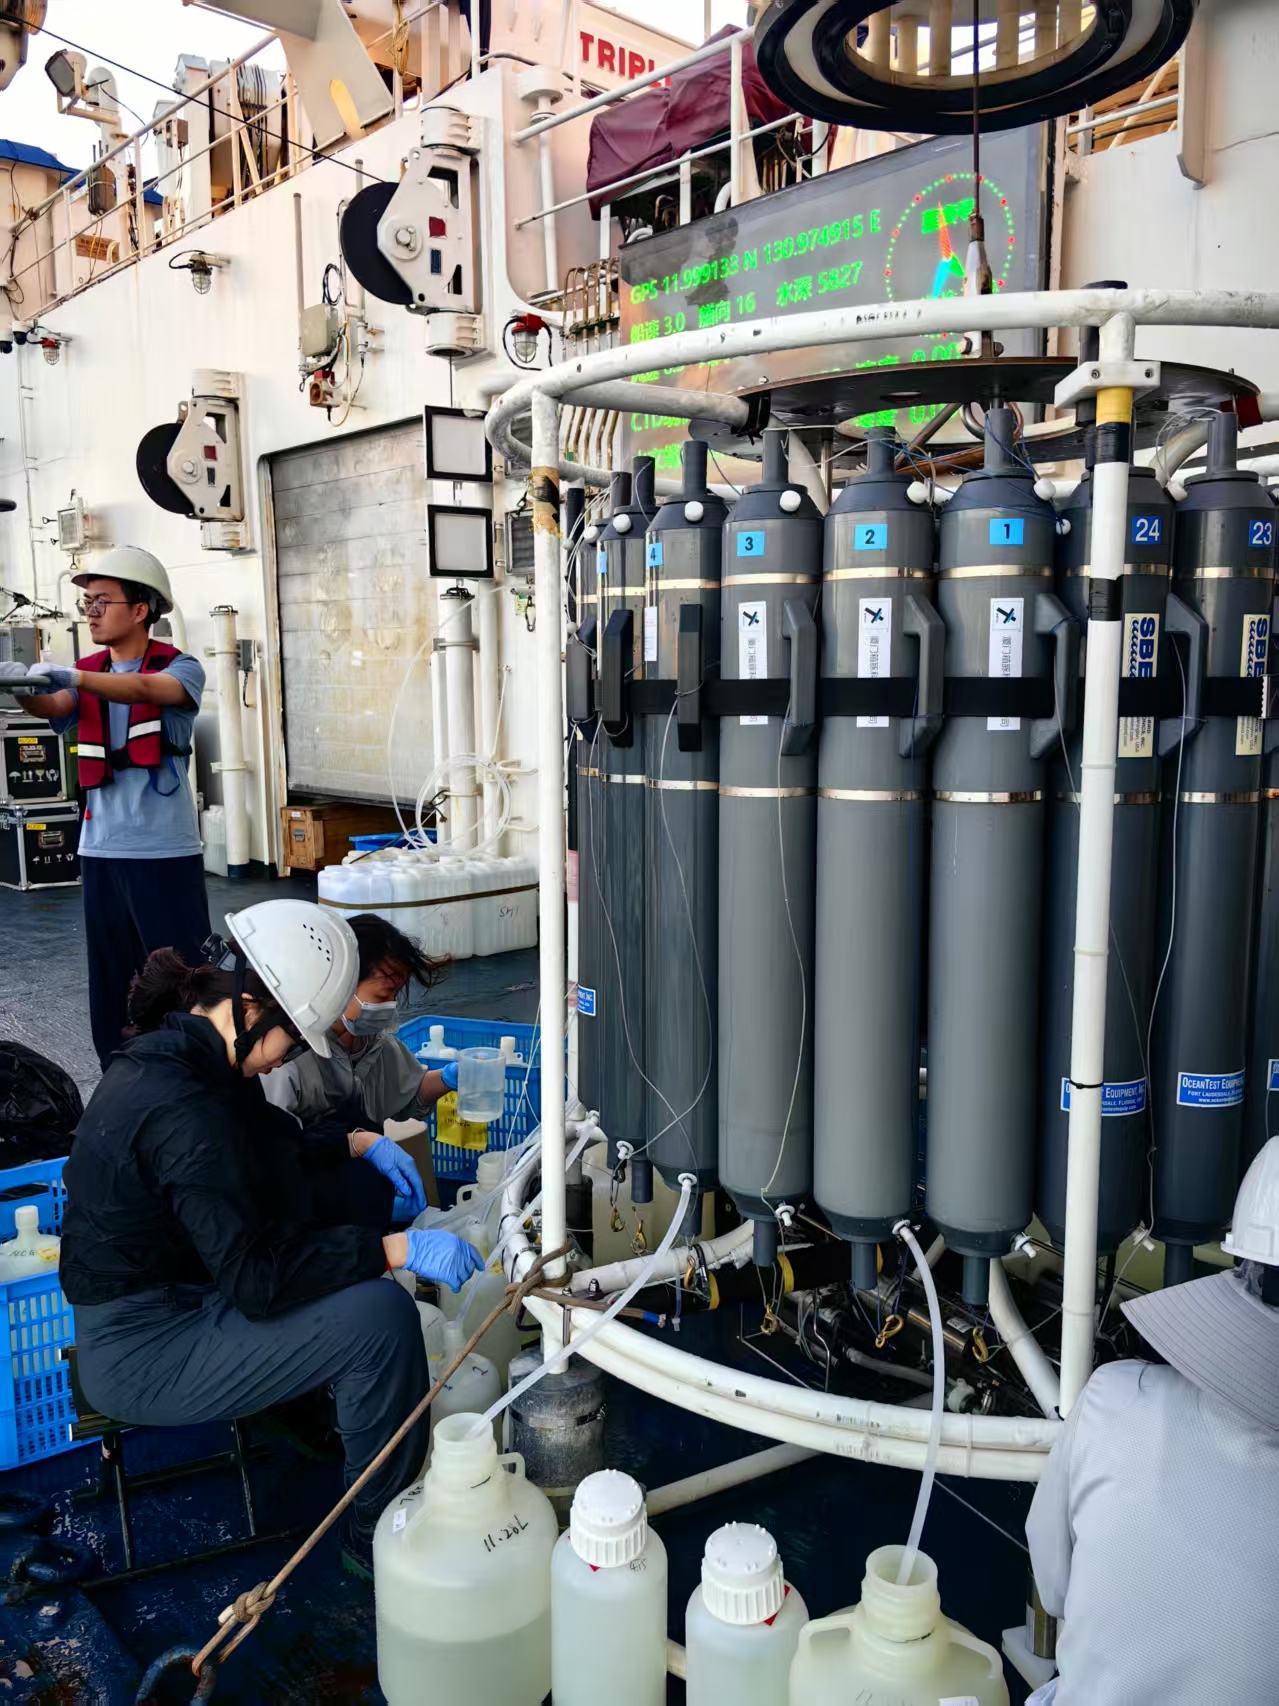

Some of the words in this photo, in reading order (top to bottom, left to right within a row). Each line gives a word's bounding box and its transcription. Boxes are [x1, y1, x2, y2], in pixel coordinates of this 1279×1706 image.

[630, 280, 658, 305] GPS
[662, 254, 740, 296] 11.999133
[743, 248, 758, 272] N
[763, 214, 864, 266] 130.974915
[870, 208, 881, 233] E
[664, 311, 686, 336] 3.0
[736, 292, 756, 316] 16
[776, 275, 813, 308] 水深
[818, 261, 864, 296] 5827
[864, 529, 876, 545] 2
[1003, 523, 1011, 540] 1
[1135, 518, 1160, 542] 24
[1252, 521, 1273, 545] 23
[650, 547, 656, 561] 4
[744, 536, 754, 551] 3
[483, 1514, 529, 1552] 11.20L
